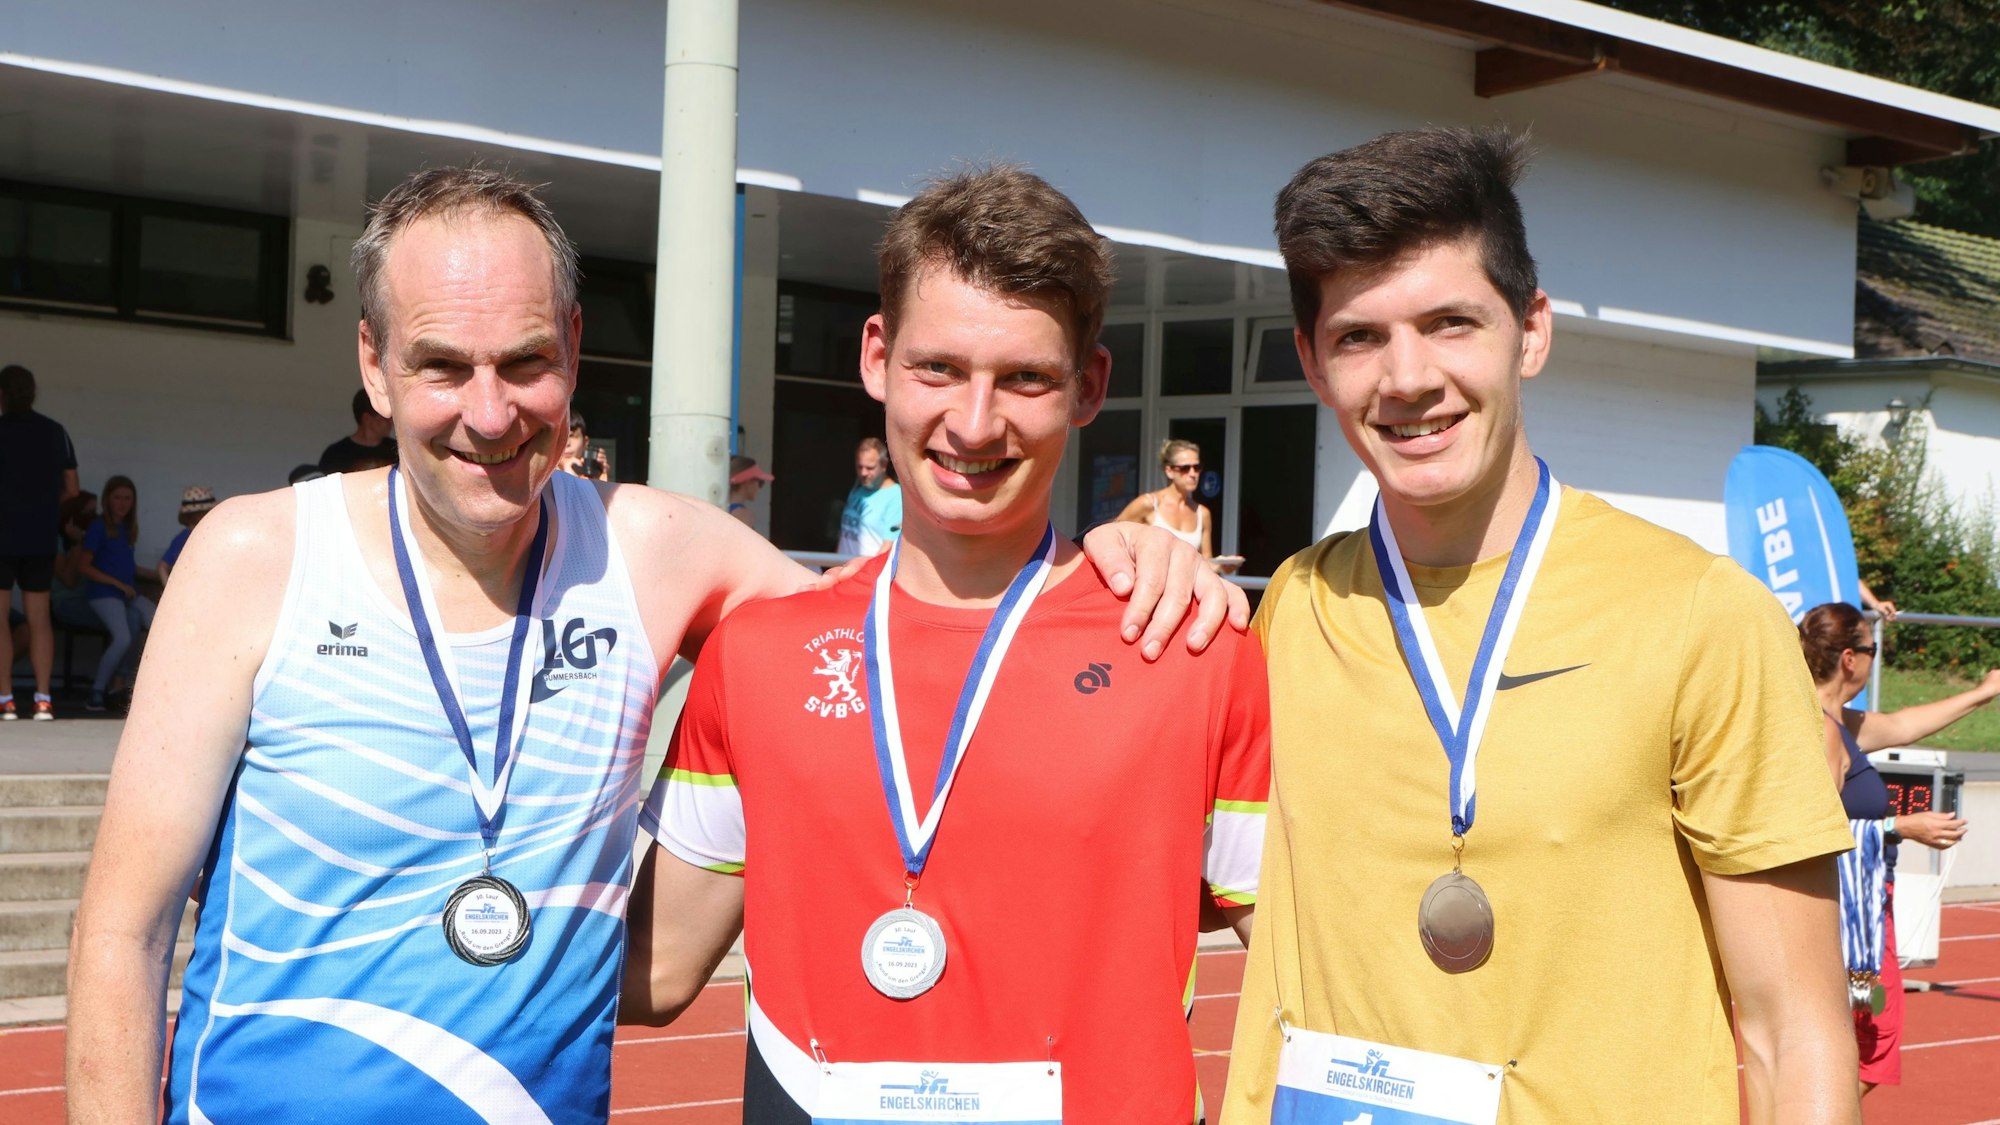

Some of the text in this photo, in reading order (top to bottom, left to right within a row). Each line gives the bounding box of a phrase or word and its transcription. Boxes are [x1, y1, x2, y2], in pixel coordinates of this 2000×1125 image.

[316, 642, 369, 657] erima
[543, 672, 598, 682] GUMMERSBACH
[882, 946, 925, 954] ENGELSKIRCHEN
[1326, 1070, 1415, 1100] ENGELSKIRCHEN
[880, 1096, 980, 1111] ENGELSKIRCHEN
